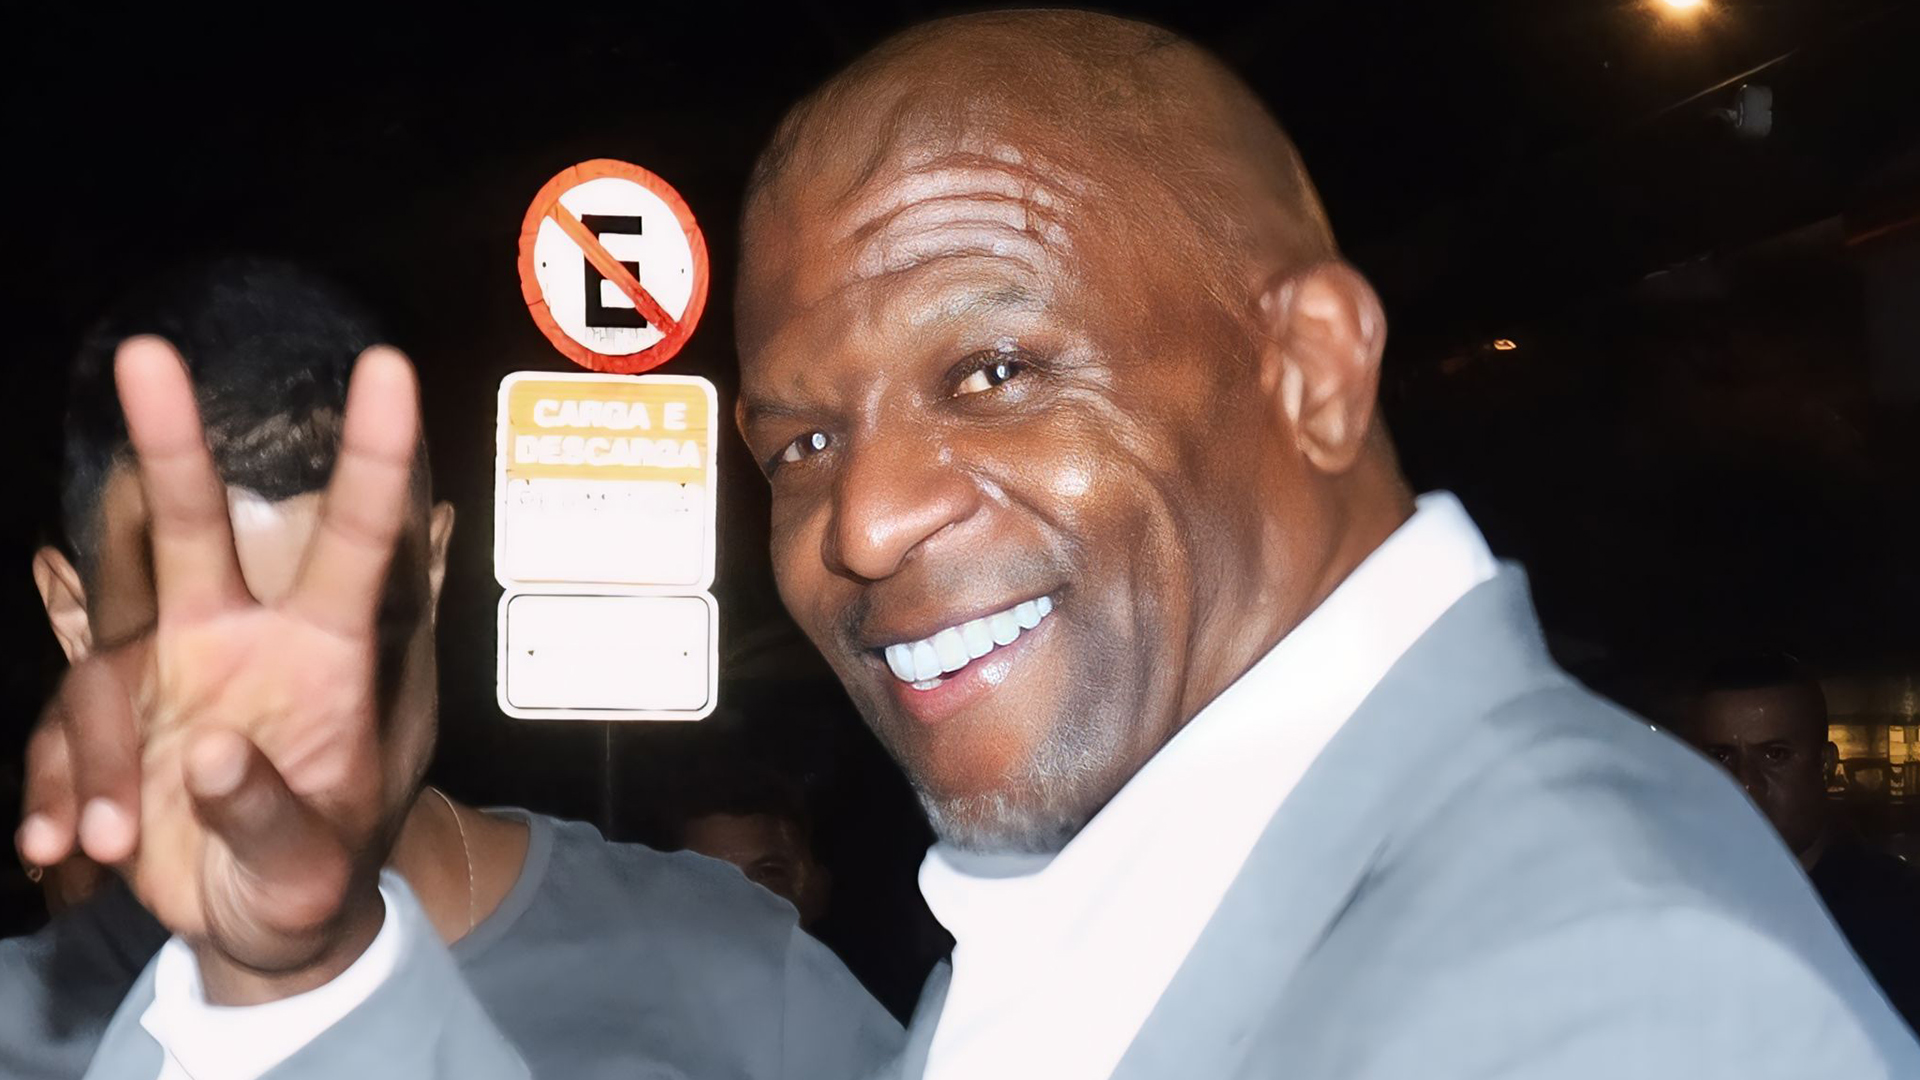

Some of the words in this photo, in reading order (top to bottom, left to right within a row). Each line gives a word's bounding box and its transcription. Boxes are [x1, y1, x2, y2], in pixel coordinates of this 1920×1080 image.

[581, 214, 647, 328] E
[534, 399, 650, 429] CARGA
[663, 402, 687, 431] E
[515, 434, 701, 469] DESCARGA
